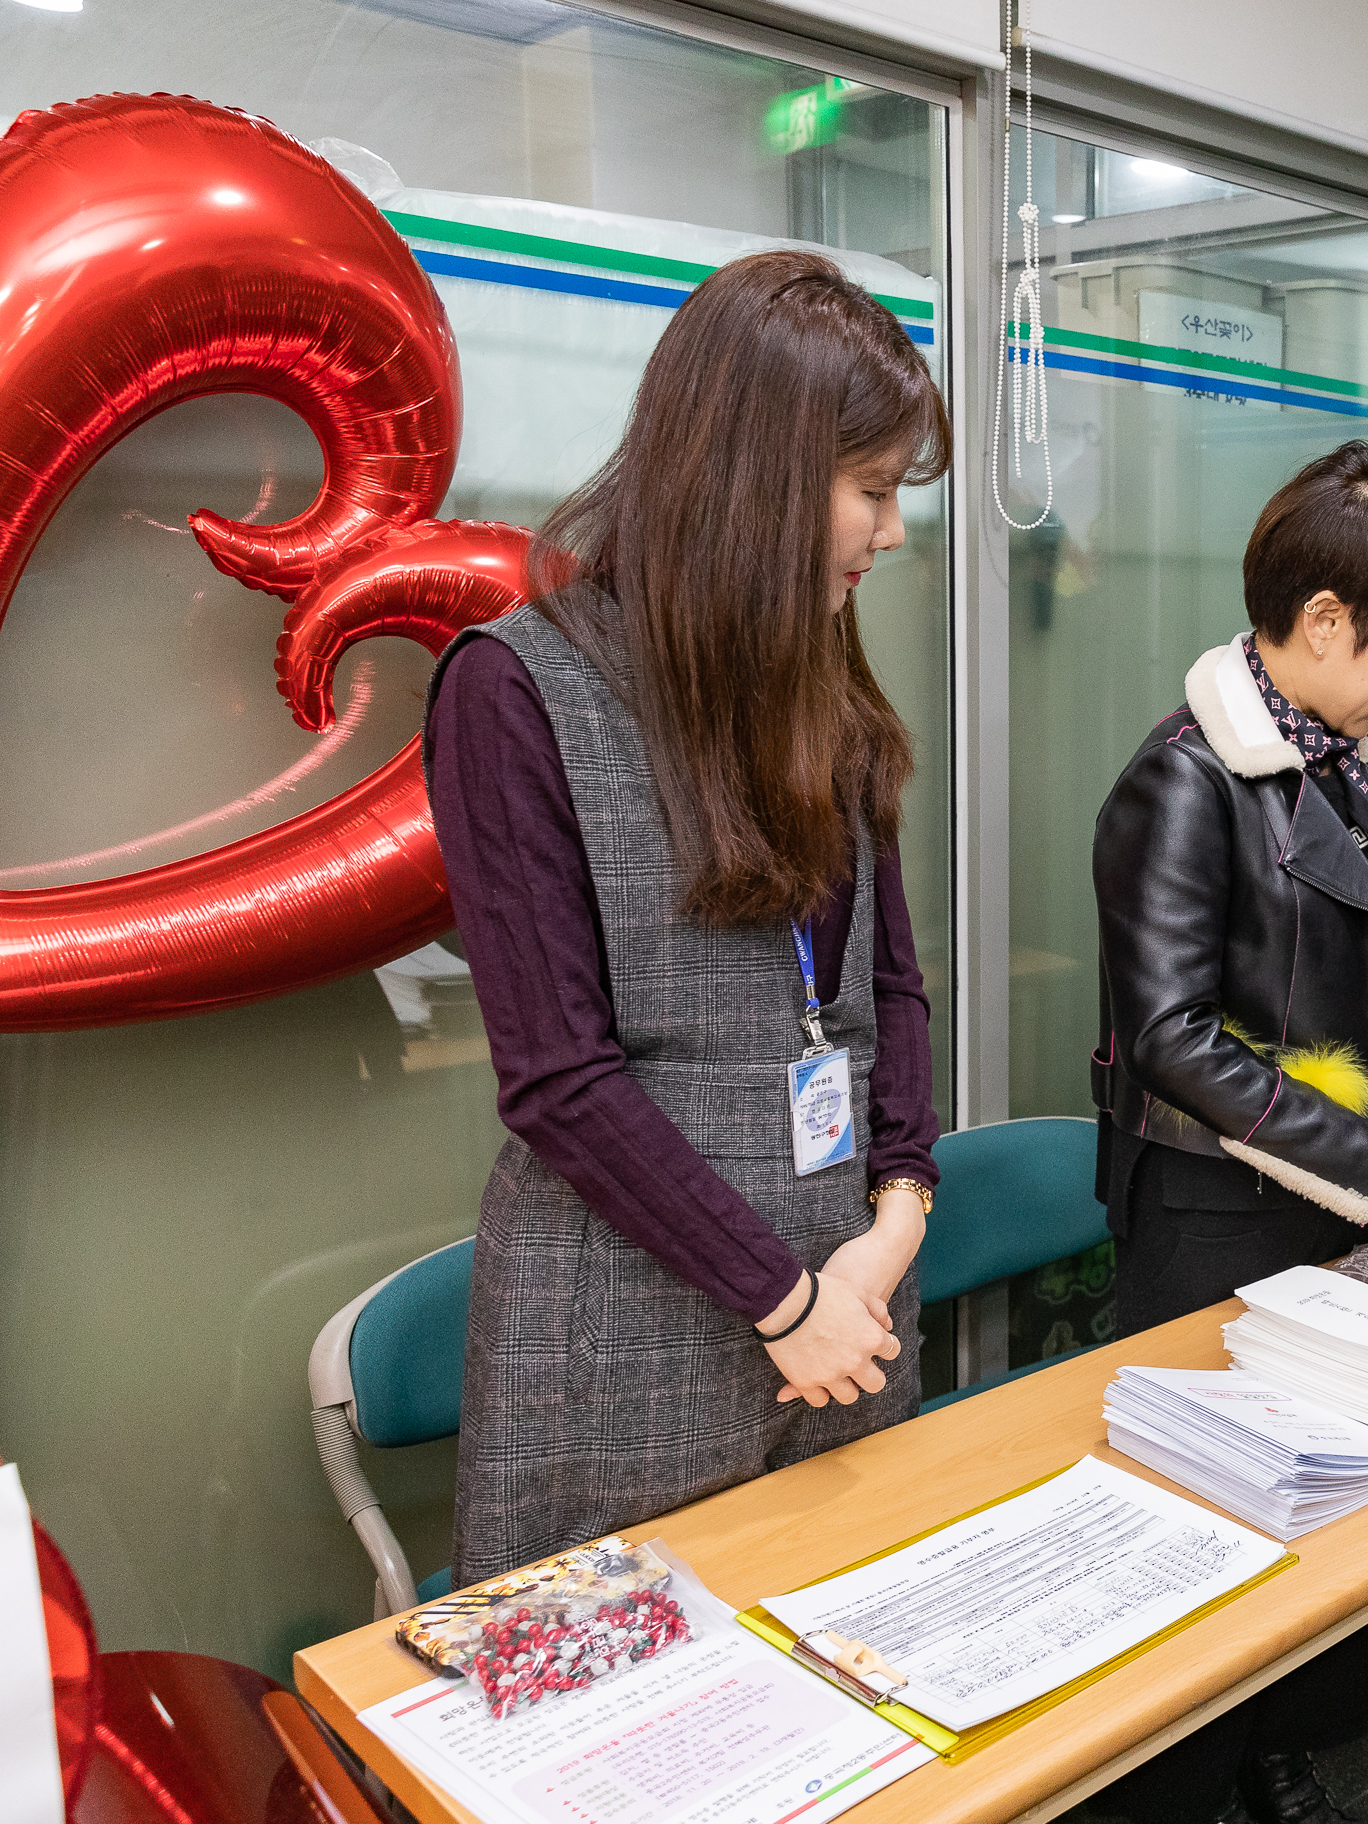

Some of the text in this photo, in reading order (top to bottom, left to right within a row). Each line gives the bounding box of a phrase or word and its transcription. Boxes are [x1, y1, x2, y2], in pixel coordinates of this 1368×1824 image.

[1181, 314, 1254, 342] <우산꽂이>
[556, 1759, 580, 1773] 2019
[582, 1739, 620, 1759] 희망온돌
[698, 1688, 718, 1700] 참여
[718, 1678, 738, 1689] 방법
[603, 1726, 670, 1762] 사회복지공동모금회
[823, 1732, 903, 1781] 중곡제2동주민센터
